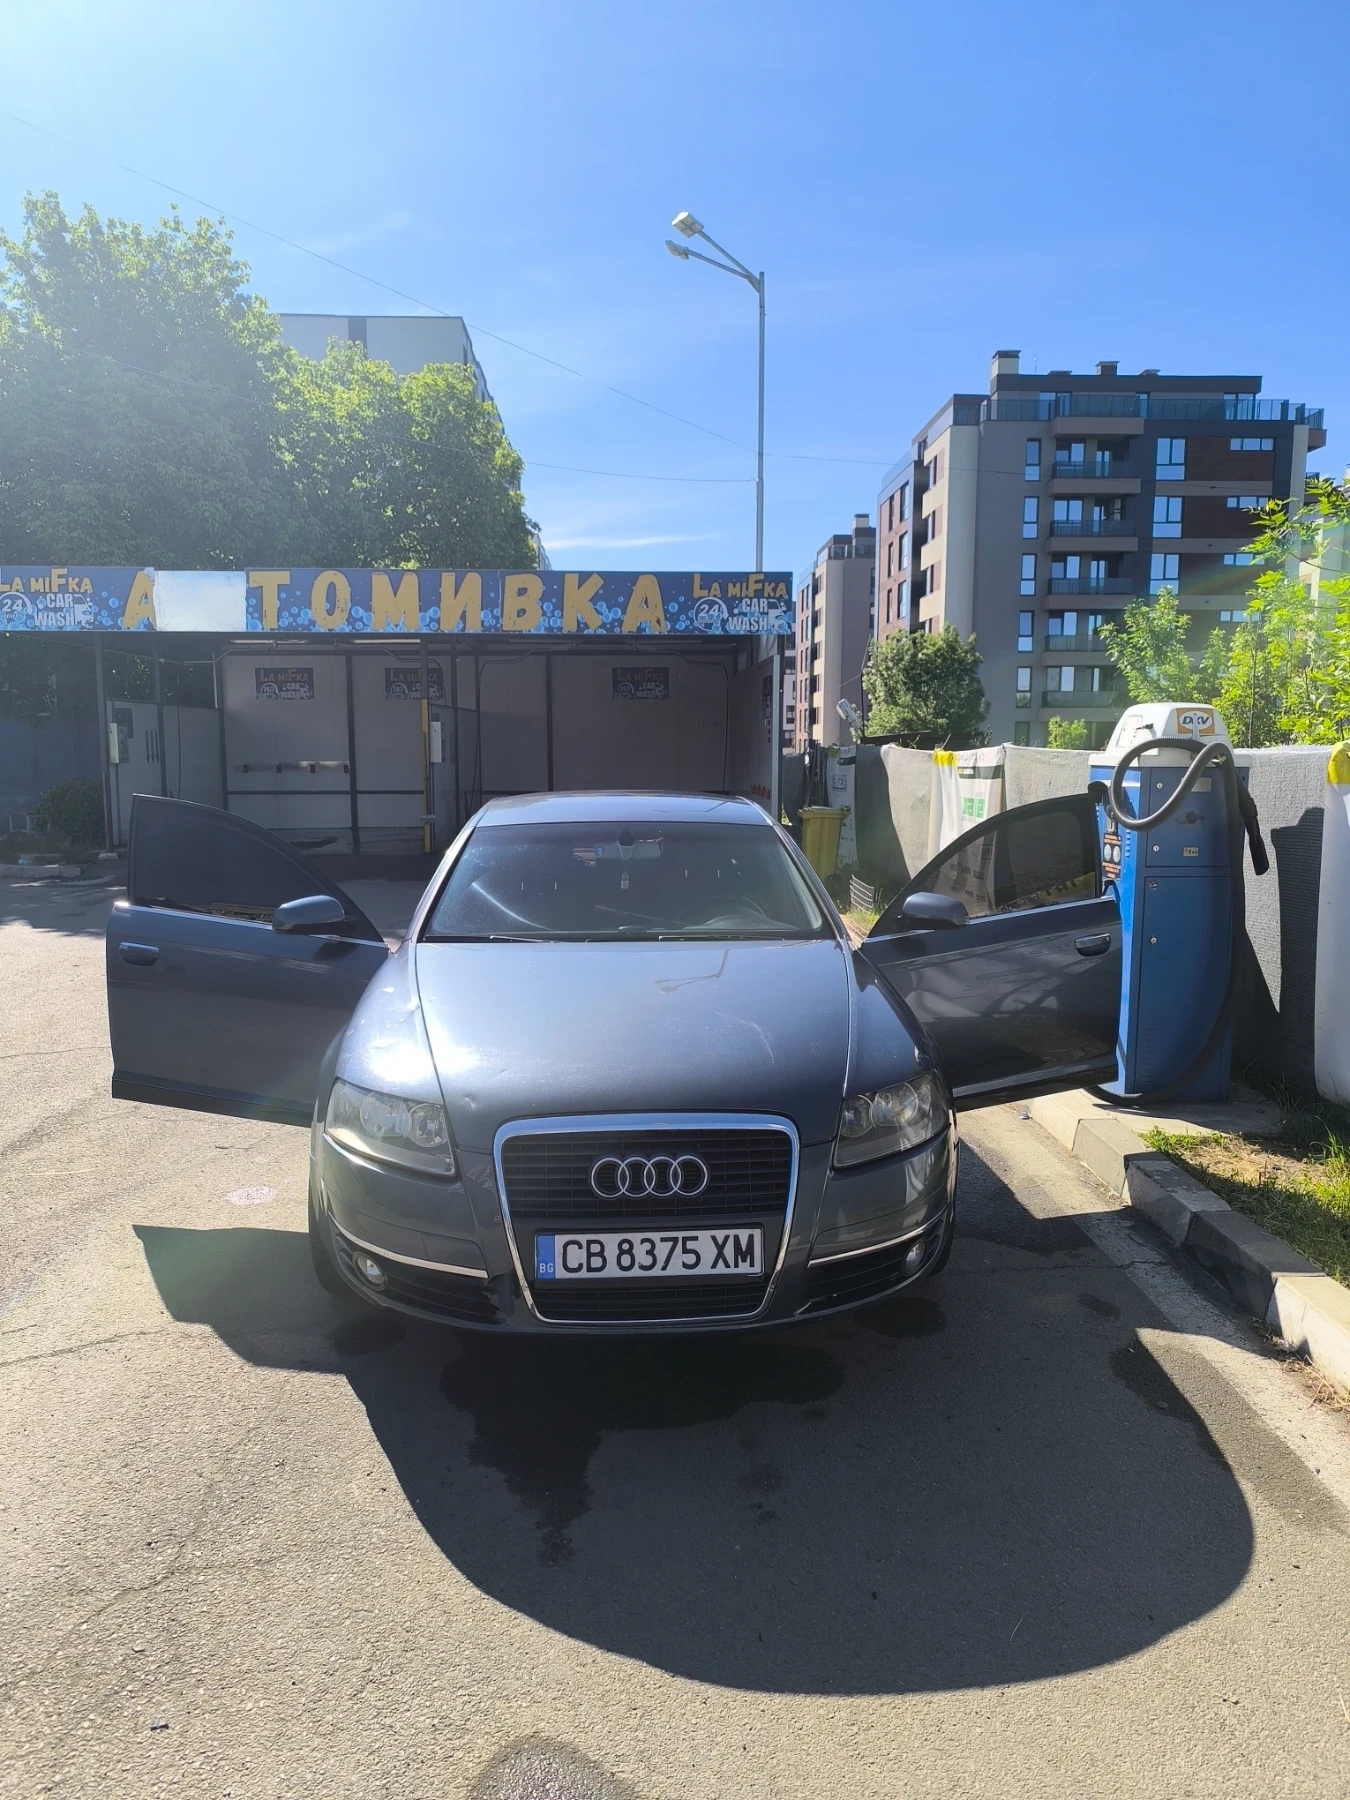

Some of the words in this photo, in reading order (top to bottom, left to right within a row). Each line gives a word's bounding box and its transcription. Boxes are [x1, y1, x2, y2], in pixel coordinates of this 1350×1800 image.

[2, 598, 24, 612] 24
[46, 593, 74, 608] CAR
[123, 570, 667, 632] АТОМИВКА
[742, 598, 768, 612] CAR
[698, 604, 720, 617] 24
[34, 611, 75, 626] WASH
[729, 616, 768, 631] WASH
[561, 1240, 607, 1273] CB
[616, 1236, 701, 1271] 8375
[710, 1233, 755, 1269] XM
[539, 1262, 554, 1274] BG
